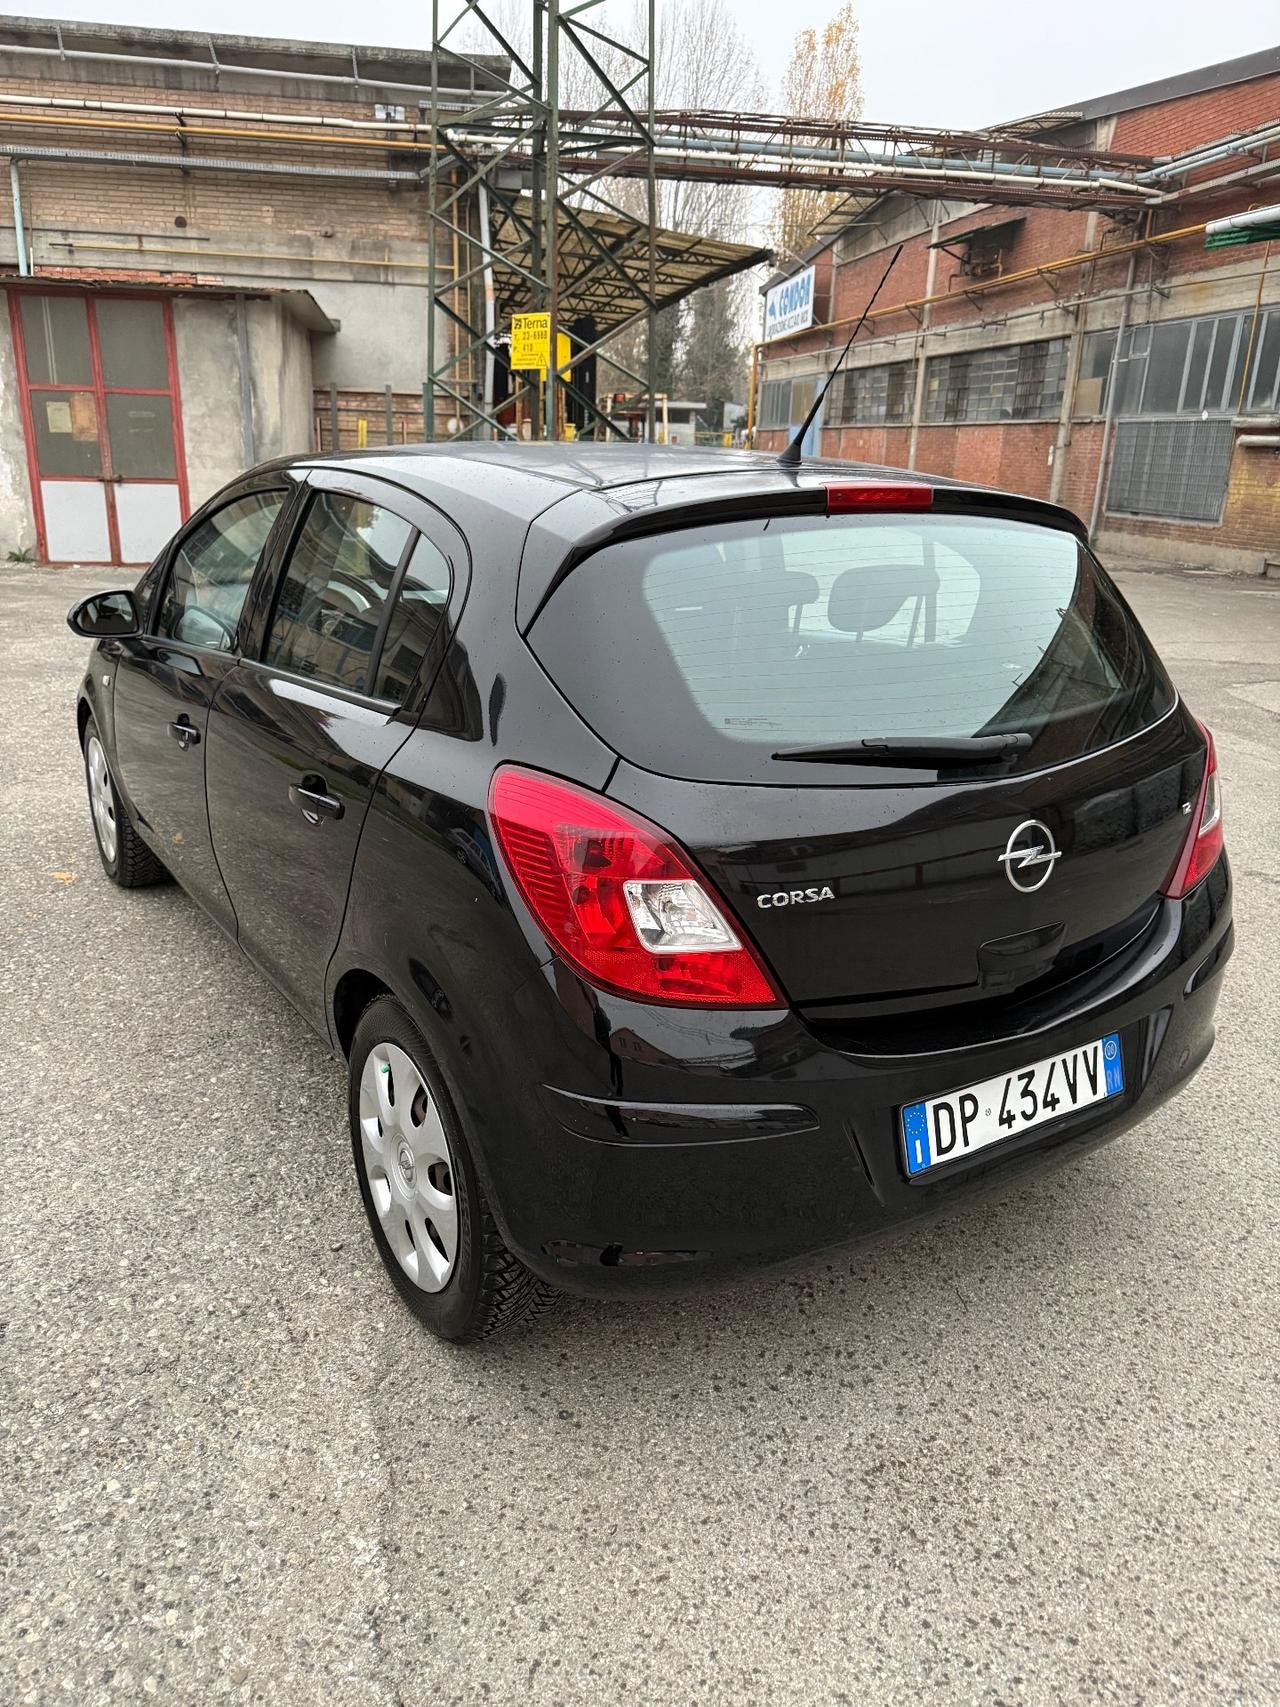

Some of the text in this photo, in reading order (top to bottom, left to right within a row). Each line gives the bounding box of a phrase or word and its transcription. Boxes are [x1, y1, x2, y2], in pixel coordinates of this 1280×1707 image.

[523, 317, 548, 329] Terna
[756, 886, 836, 909] CORSA
[932, 1046, 1098, 1156] DP 434VV
